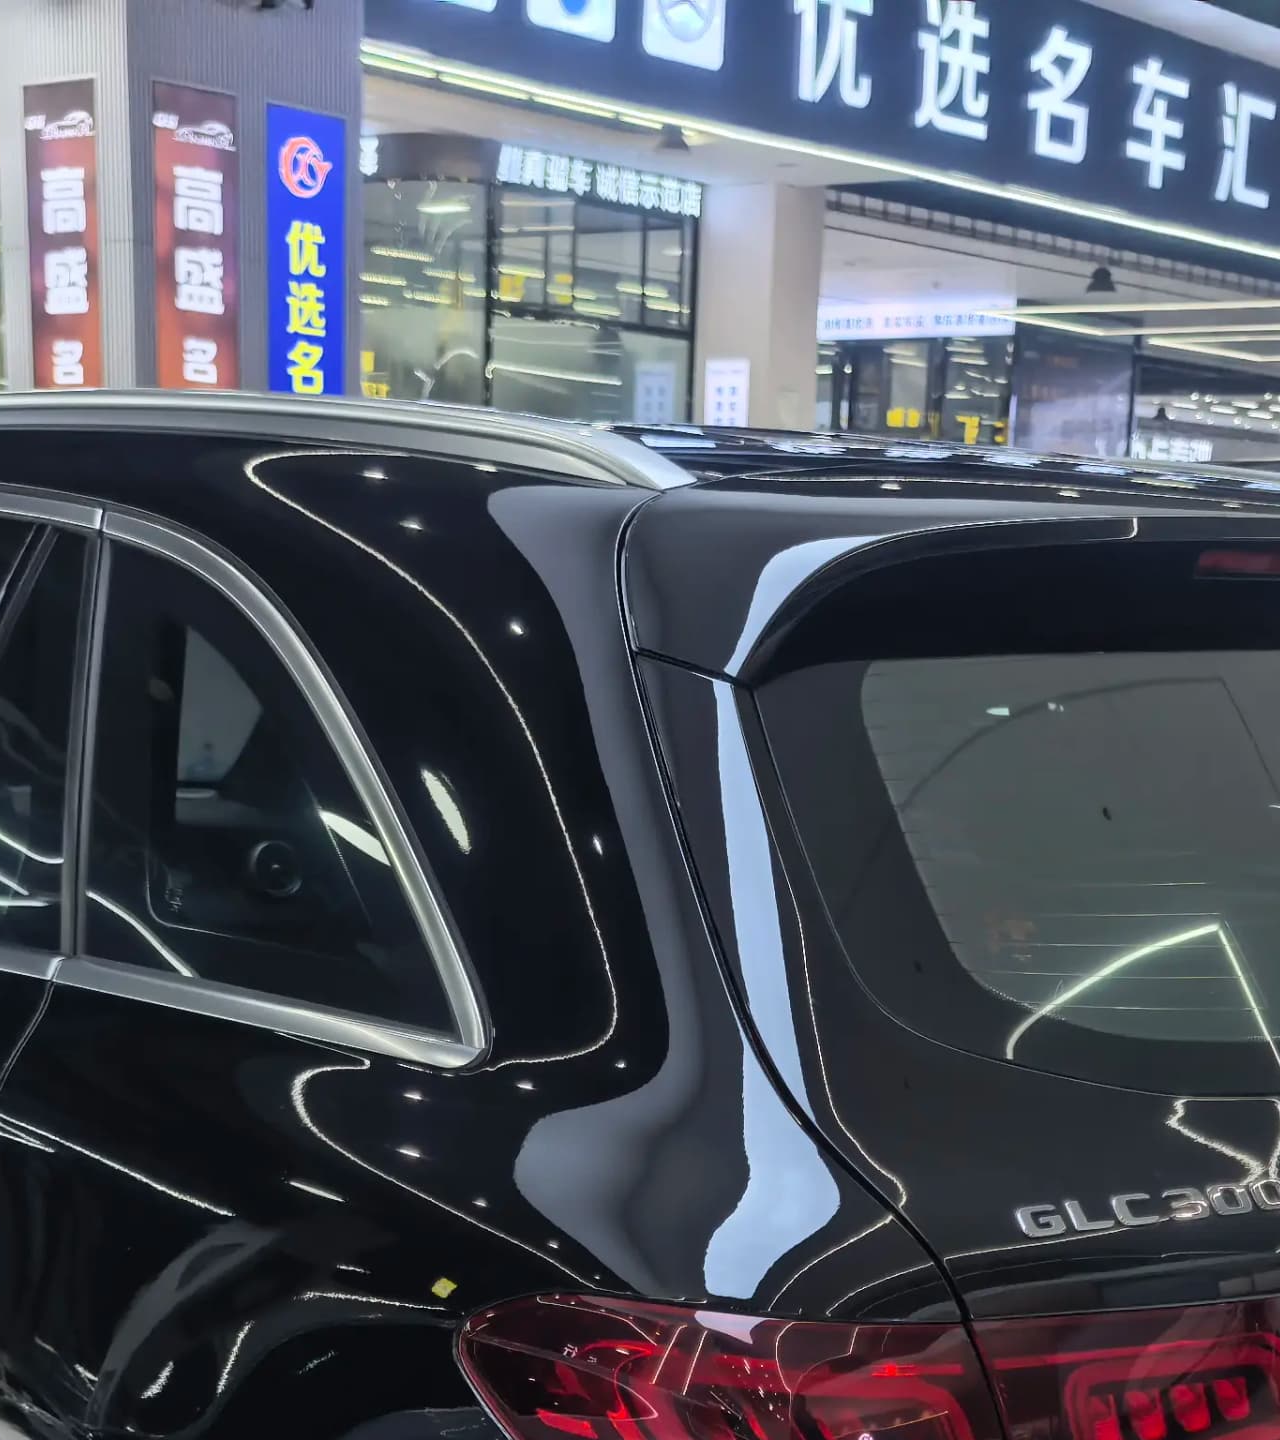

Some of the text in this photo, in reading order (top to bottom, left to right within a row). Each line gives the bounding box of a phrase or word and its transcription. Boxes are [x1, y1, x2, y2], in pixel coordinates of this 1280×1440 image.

[795, 0, 1276, 209] 优选名车汇
[285, 220, 327, 395] 优选名
